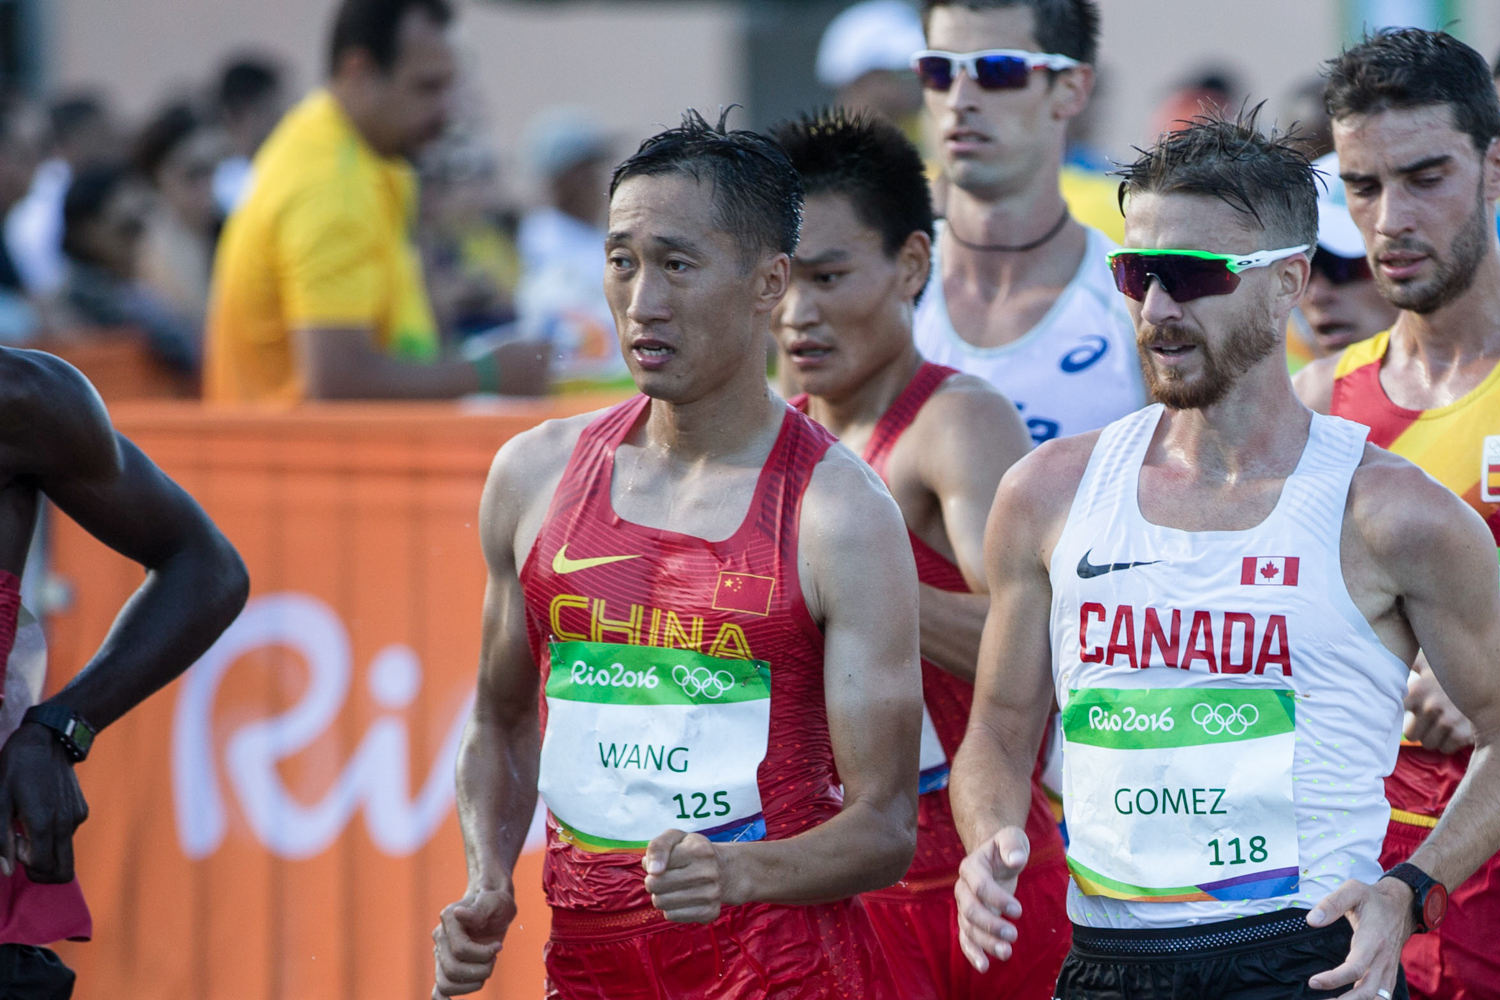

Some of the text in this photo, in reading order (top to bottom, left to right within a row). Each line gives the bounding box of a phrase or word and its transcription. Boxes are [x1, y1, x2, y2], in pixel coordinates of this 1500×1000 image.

[550, 594, 754, 661] CHINA
[1080, 602, 1293, 677] CANADA
[569, 660, 660, 689] Rio2016
[170, 592, 478, 861] Ri
[1088, 705, 1175, 732] Rio2016
[598, 742, 689, 773] WANG
[672, 791, 732, 820] 125
[1114, 788, 1228, 816] GOMEZ
[1207, 835, 1269, 867] 118
